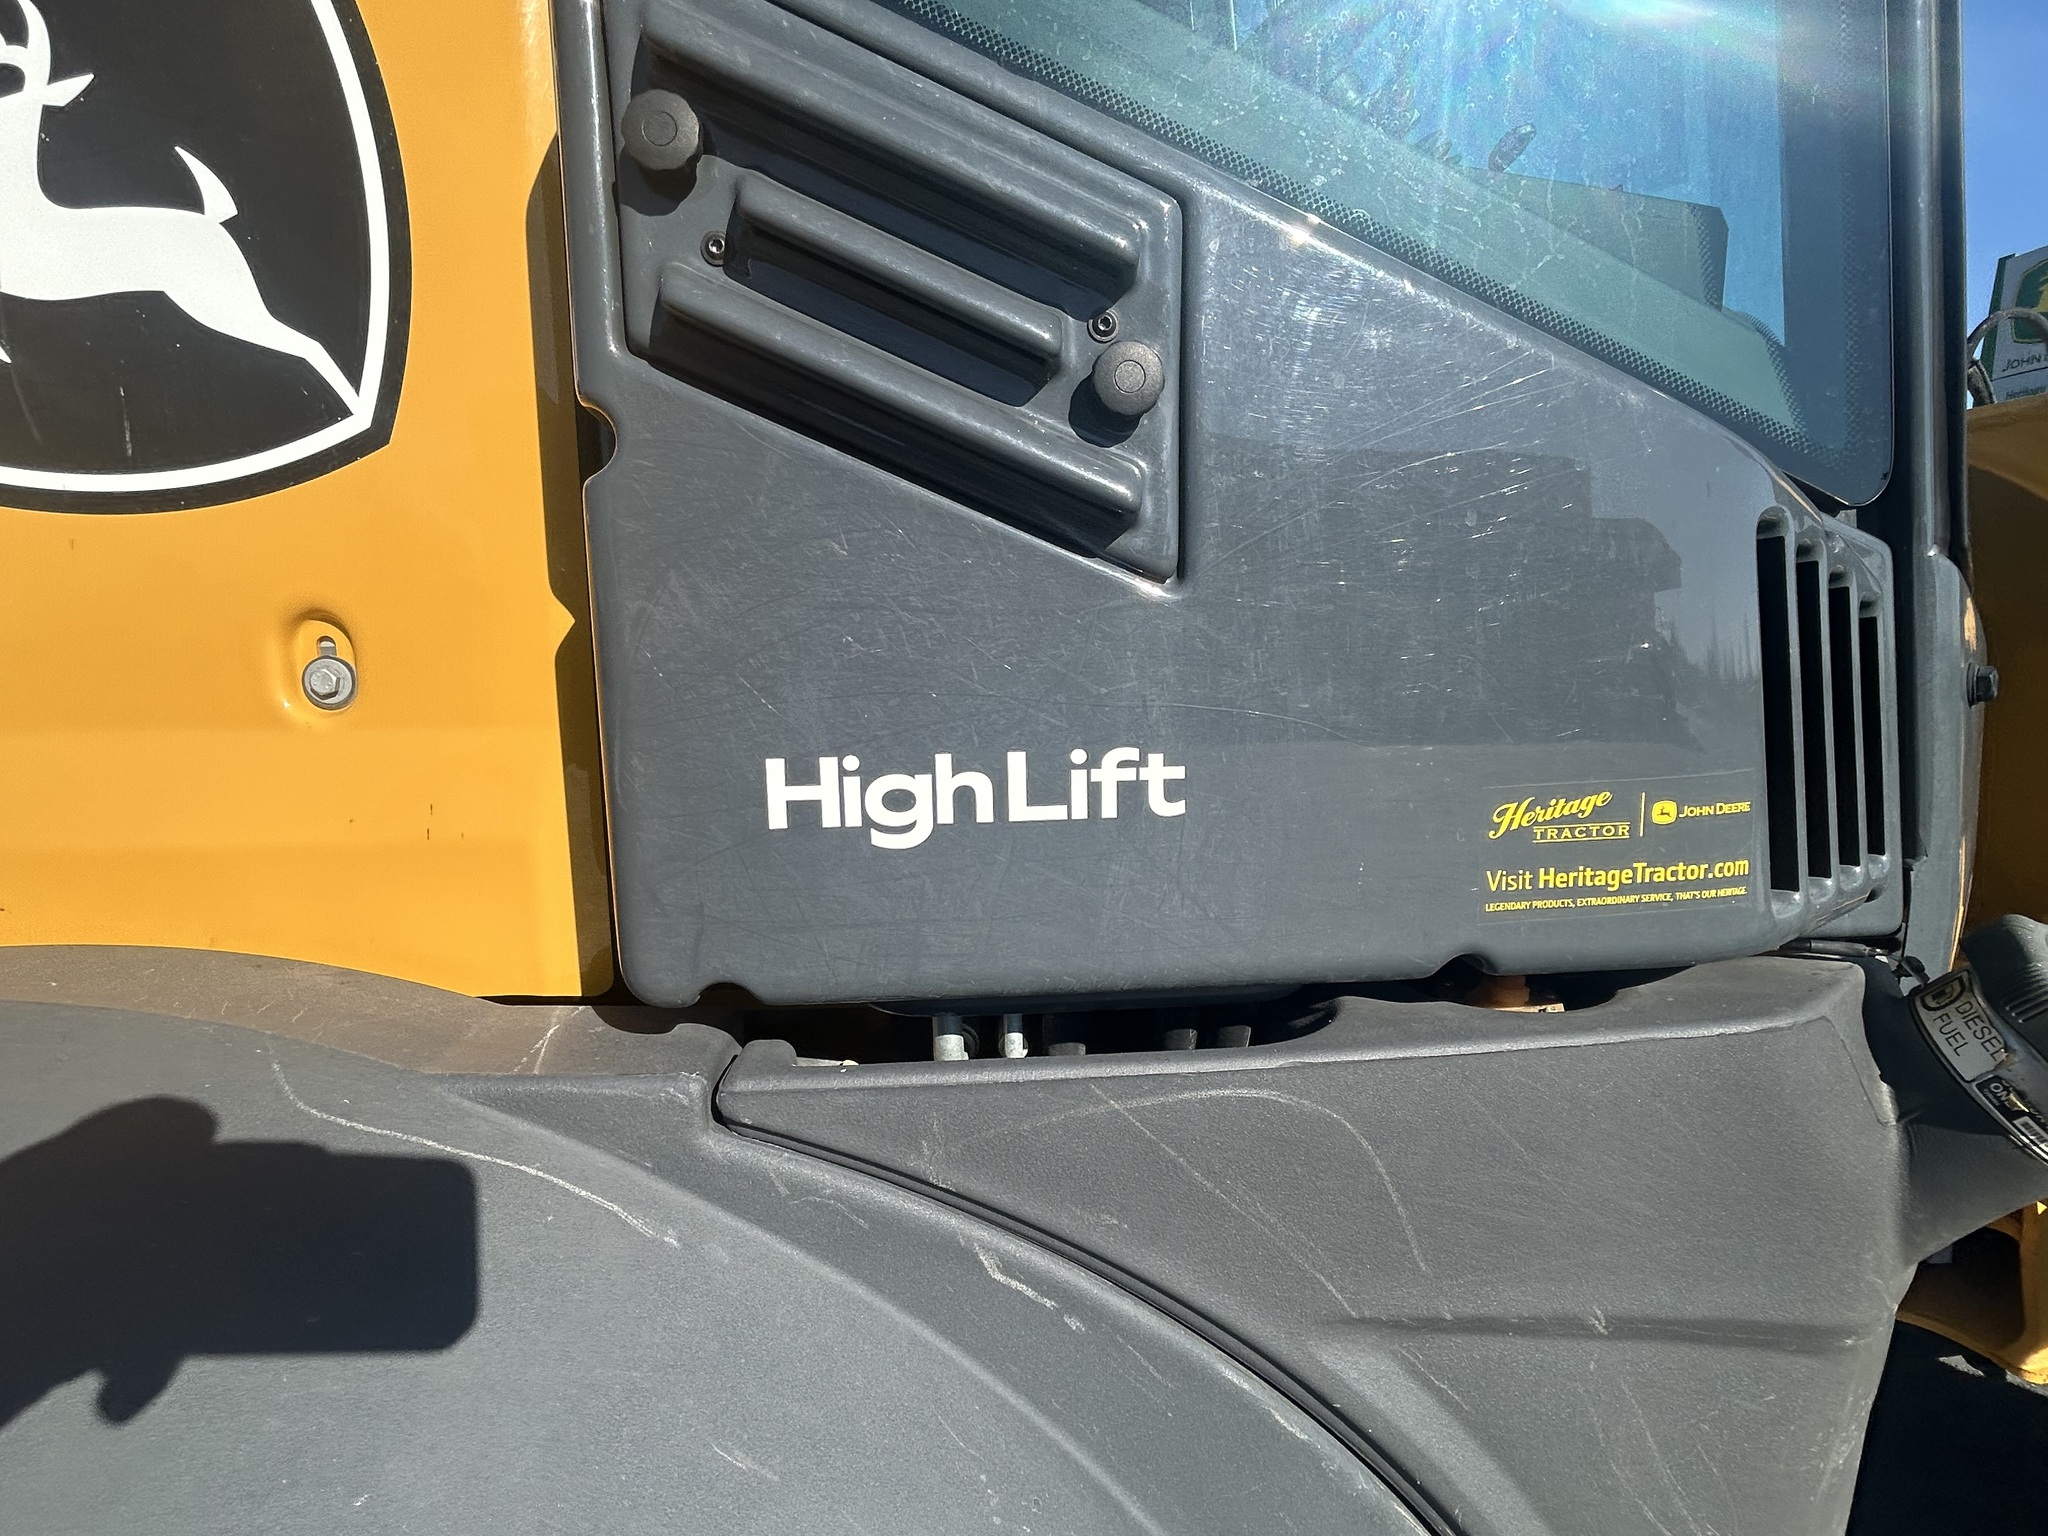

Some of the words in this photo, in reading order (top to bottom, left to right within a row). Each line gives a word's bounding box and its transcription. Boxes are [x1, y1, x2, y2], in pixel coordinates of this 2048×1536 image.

[2002, 354, 2041, 372] JOHN
[765, 753, 995, 850] High
[1007, 747, 1186, 822] Lift
[1488, 791, 1613, 839] Heritage
[1679, 805, 1714, 818] JOHN
[1716, 801, 1751, 815] DEERE
[1533, 824, 1630, 840] TRACTOR
[1486, 869, 1533, 892] Visit
[1539, 859, 1749, 891] HeritageTractor.com
[1485, 901, 1531, 912] LEGENDARY
[1532, 898, 1575, 909] PRODUCTS,
[1577, 894, 1640, 907] EXTRAORDINARY
[1641, 893, 1674, 903] SERVICE,
[1675, 890, 1701, 900] THAT'S
[1701, 889, 1716, 899] OUR
[1933, 1013, 1969, 1057] FUEL
[1955, 1001, 2005, 1061] DIESEL
